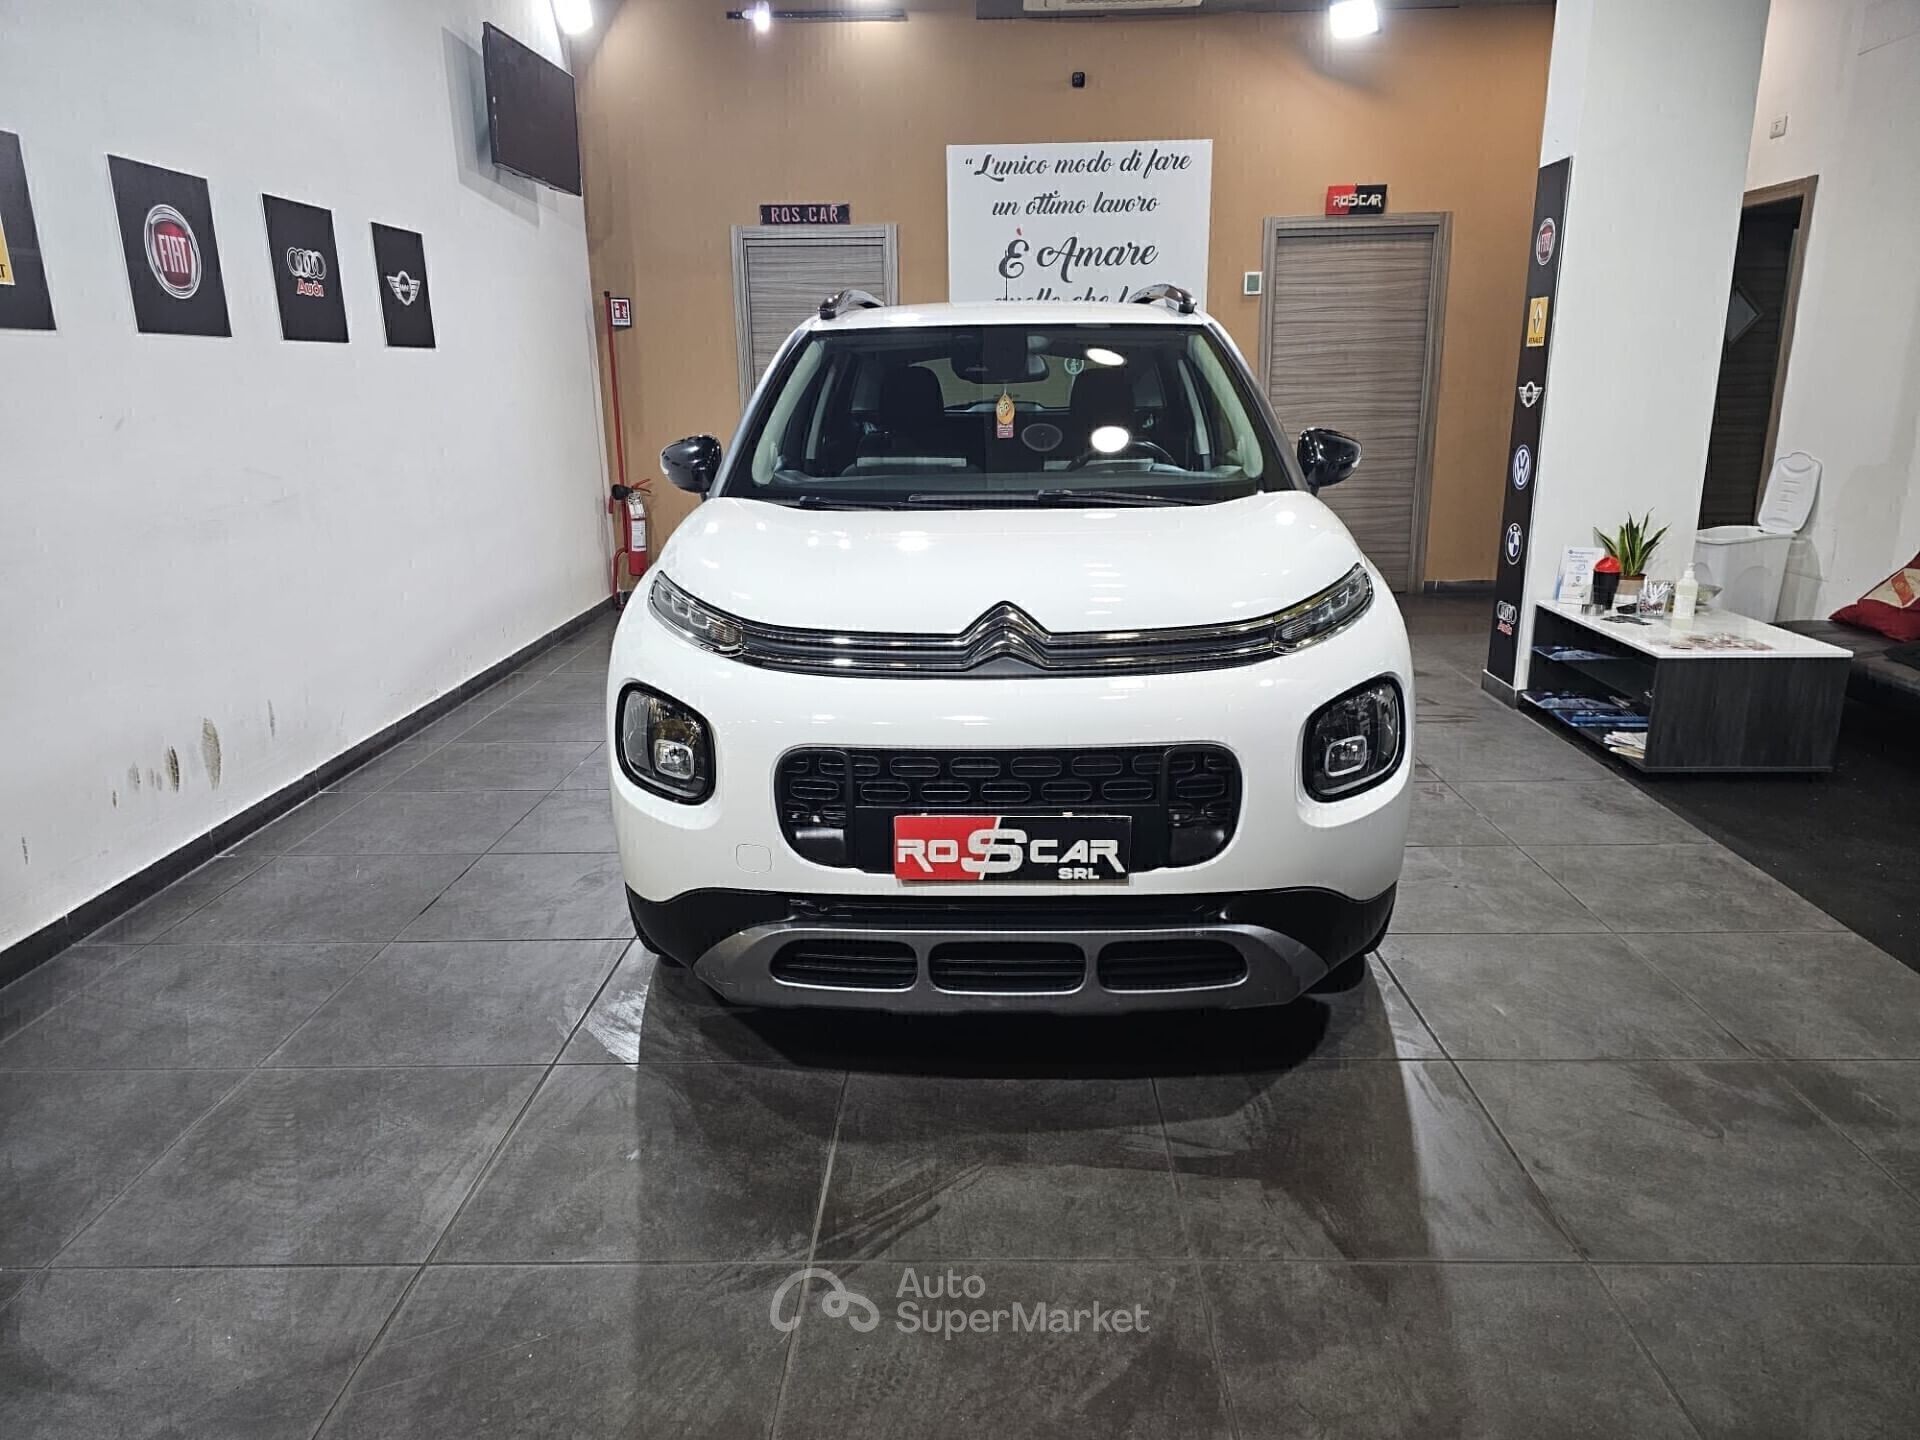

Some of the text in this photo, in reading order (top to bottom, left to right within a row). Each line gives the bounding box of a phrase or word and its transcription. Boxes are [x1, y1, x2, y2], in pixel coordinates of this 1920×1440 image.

[1054, 151, 1111, 173] modo
[1119, 149, 1142, 172] di
[1143, 148, 1191, 179] fare
[992, 190, 1159, 216] un ottimo lavoro
[1332, 194, 1382, 208] ROSCAR
[771, 206, 838, 223] ROS.CAR
[158, 234, 189, 274] FIAT
[998, 227, 1159, 283] È Amare
[296, 279, 325, 297] Audi
[1058, 867, 1100, 880] SRL
